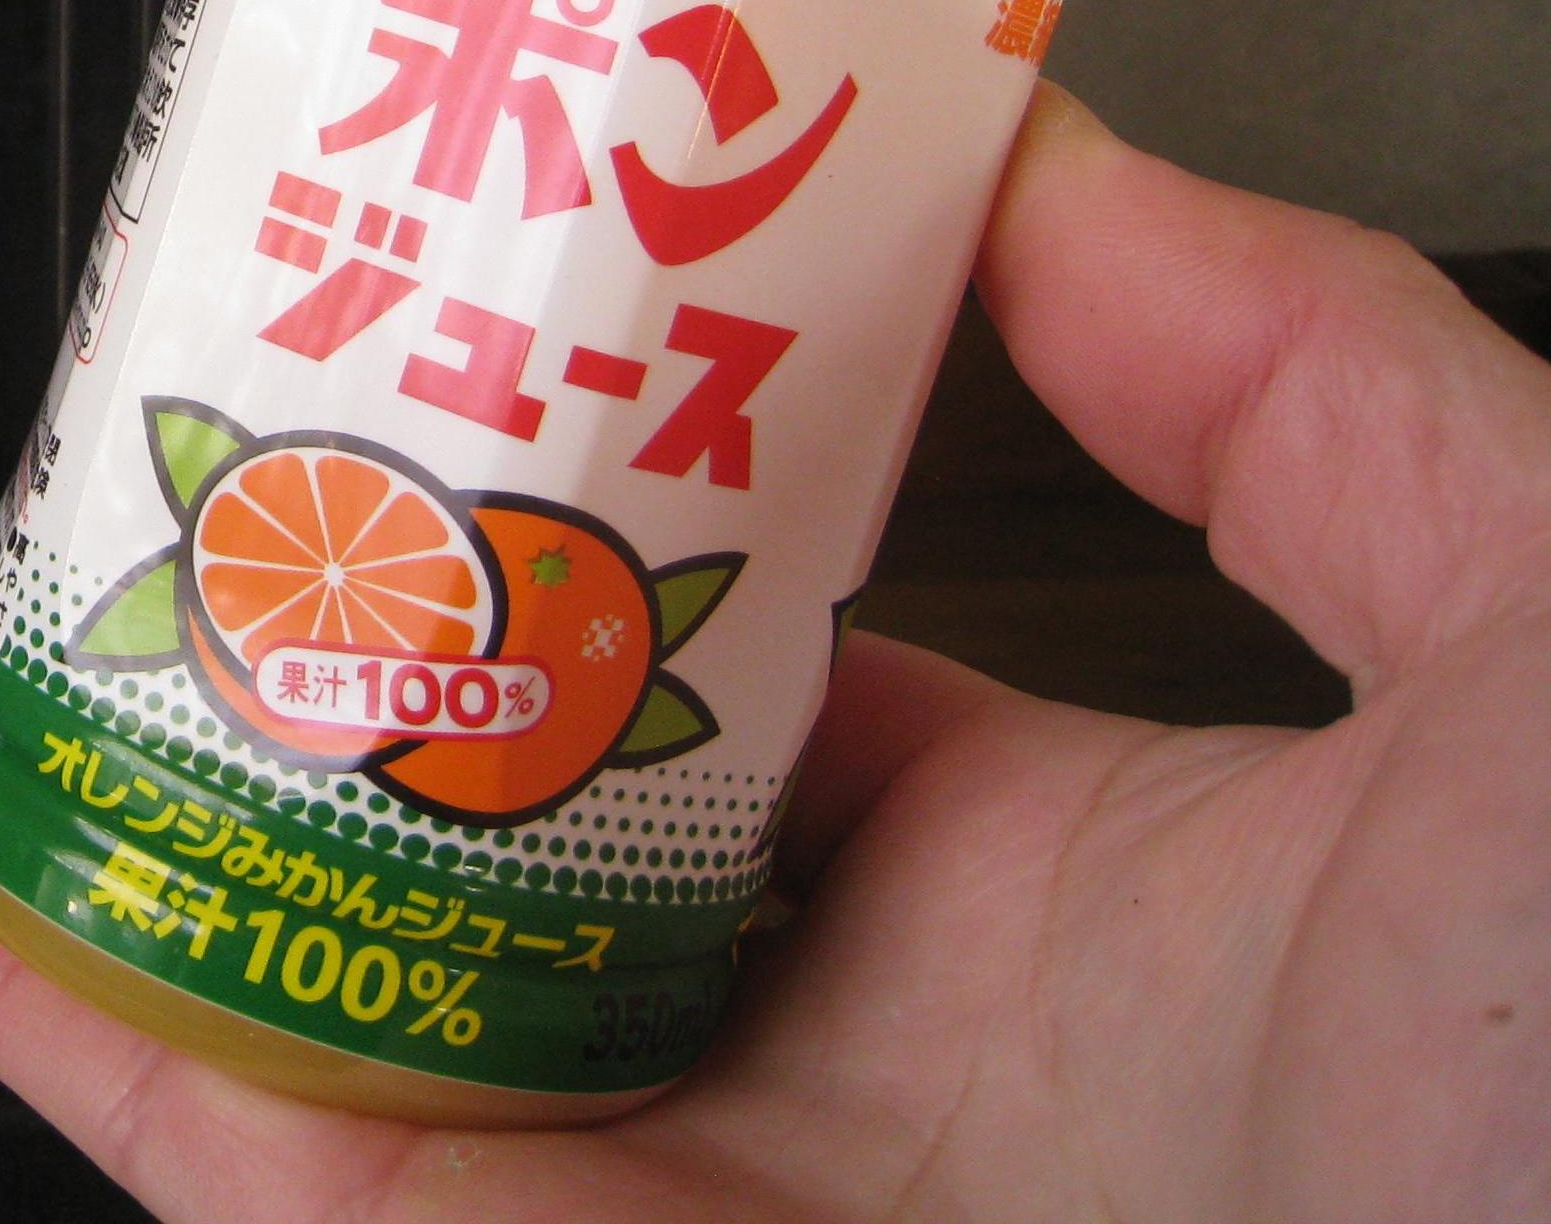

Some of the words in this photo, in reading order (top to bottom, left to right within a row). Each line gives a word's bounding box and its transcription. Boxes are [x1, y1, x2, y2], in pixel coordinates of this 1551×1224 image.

[253, 170, 801, 492] ジュース
[276, 661, 538, 730] 果汁100%
[36, 730, 616, 973] オレンジみかんジュース
[87, 841, 484, 1048] 果汁100%
